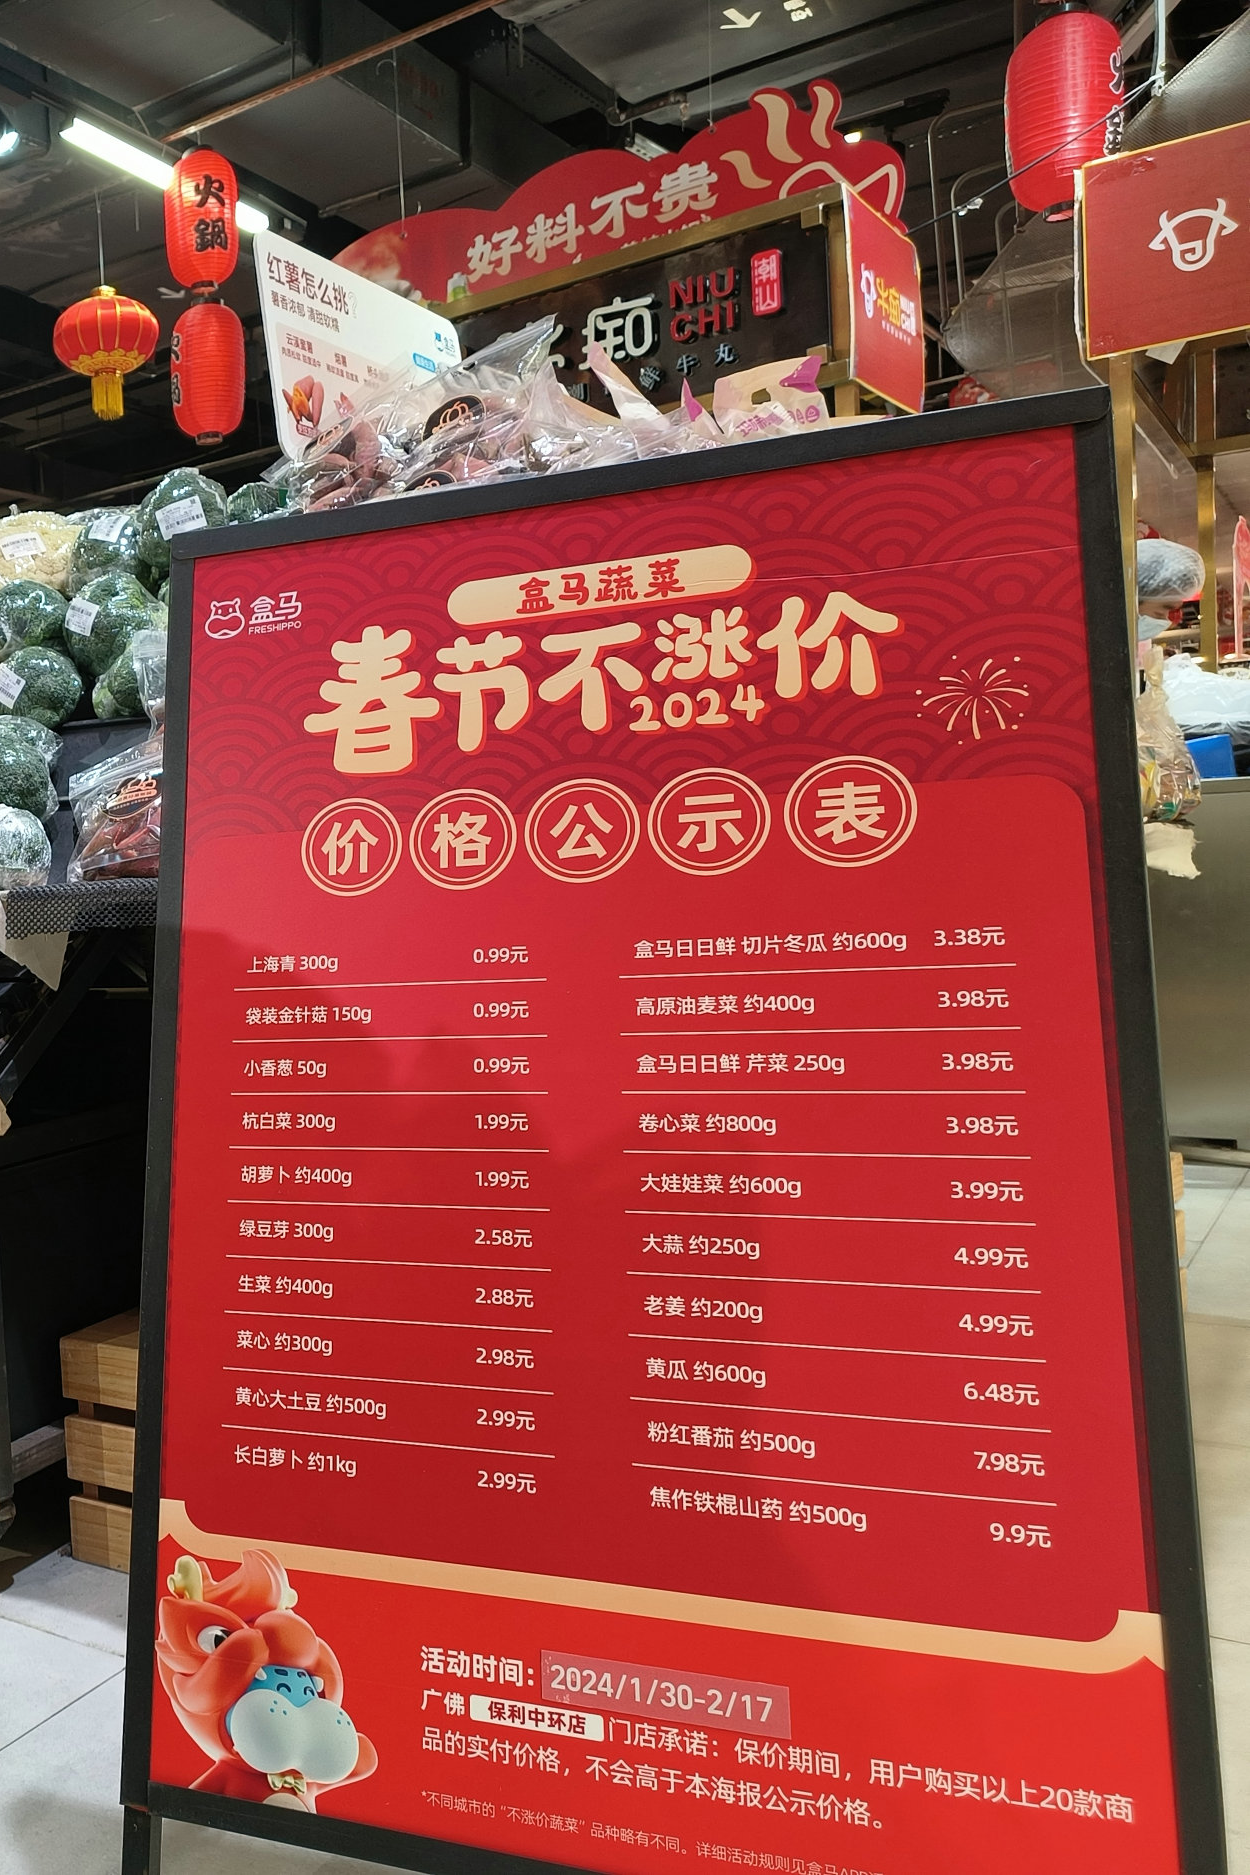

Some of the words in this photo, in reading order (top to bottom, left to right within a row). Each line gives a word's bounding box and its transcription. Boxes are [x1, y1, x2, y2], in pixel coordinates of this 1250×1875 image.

[466, 160, 718, 283] 好料不贵
[668, 266, 738, 310] NIU
[669, 300, 738, 342] CHI
[517, 557, 685, 615] 盒马蔬菜
[248, 620, 302, 635] FRESHIPPO
[249, 591, 302, 625] 盒马
[304, 591, 905, 775] 春节不涨价
[628, 684, 768, 733] 2024
[321, 780, 890, 878] 价格公示表
[246, 955, 296, 973] 上海青
[299, 955, 339, 973] 300g
[473, 945, 529, 964] 0.99元
[633, 936, 737, 959] 盒马日日鲜
[740, 933, 828, 956] 切片冬瓜
[831, 931, 907, 952] 约600g
[933, 926, 1006, 947] 3.38元
[245, 1005, 328, 1025] 袋装金针菇
[332, 1006, 372, 1025] 150g
[473, 1000, 530, 1019] 0.99元
[635, 994, 739, 1016] 高原油麦菜
[743, 993, 815, 1015] 约400g
[937, 988, 1010, 1009] 3.98元
[243, 1058, 294, 1077] 小香葱
[297, 1060, 327, 1079] 50g
[473, 1056, 530, 1075] 0.99元
[636, 1053, 741, 1074] 盒马日日鲜
[745, 1052, 789, 1074] 芹菜
[793, 1054, 845, 1075] 250g
[941, 1051, 1014, 1073] 3.98元
[241, 1111, 292, 1130] 杭白菜
[295, 1113, 336, 1133] 300g
[474, 1113, 529, 1132] 1.99元
[638, 1113, 701, 1134] 卷心菜
[705, 1113, 777, 1136] 约800g
[946, 1115, 1019, 1137] 3.98元
[240, 1165, 291, 1184] 胡萝卜
[294, 1166, 352, 1188] 约400g
[474, 1170, 530, 1190] 1.99元
[640, 1172, 725, 1194] 大娃娃菜
[728, 1174, 802, 1199] 约600g
[950, 1181, 1024, 1202] 3.99元
[238, 1219, 290, 1239] 绿豆芽
[293, 1222, 334, 1243] 300g
[474, 1228, 533, 1248] 2.58元
[642, 1233, 685, 1255] 大蒜
[688, 1234, 760, 1260] 约250g
[953, 1247, 1029, 1269] 4.99元
[237, 1274, 272, 1294] 生菜
[274, 1275, 333, 1299] 约400g
[475, 1287, 535, 1309] 2.88元
[643, 1294, 686, 1318] 老姜
[690, 1296, 763, 1324] 约200g
[958, 1313, 1034, 1337] 4.99元
[236, 1329, 271, 1350] 菜心
[273, 1332, 333, 1357] 约300g
[475, 1347, 535, 1369] 2.98元
[645, 1357, 689, 1381] 黄瓜
[692, 1360, 767, 1389] 约600g
[963, 1381, 1040, 1406] 6.48元
[235, 1386, 322, 1412] 黄心大土豆
[325, 1393, 387, 1420] 约500g
[476, 1408, 536, 1431] 2.99元
[233, 1443, 304, 1470] 长白萝卜
[307, 1451, 357, 1478] 约1kg
[477, 1470, 537, 1494] 2.99元
[647, 1420, 735, 1449] 粉红番茄
[739, 1429, 816, 1459] 约500g
[973, 1451, 1046, 1477] 7.98元
[649, 1485, 783, 1521] 焦作铁棍山药
[788, 1501, 867, 1533] 约500g
[989, 1522, 1052, 1549] 9.9元
[419, 1645, 535, 1688] 活动时间：
[549, 1663, 774, 1723] 2024/1/30-2/17
[420, 1688, 467, 1717] 广佛
[487, 1700, 587, 1736] 保利中环店
[421, 1726, 884, 1829] 品的实付价格，不会高于本海报公示价格。
